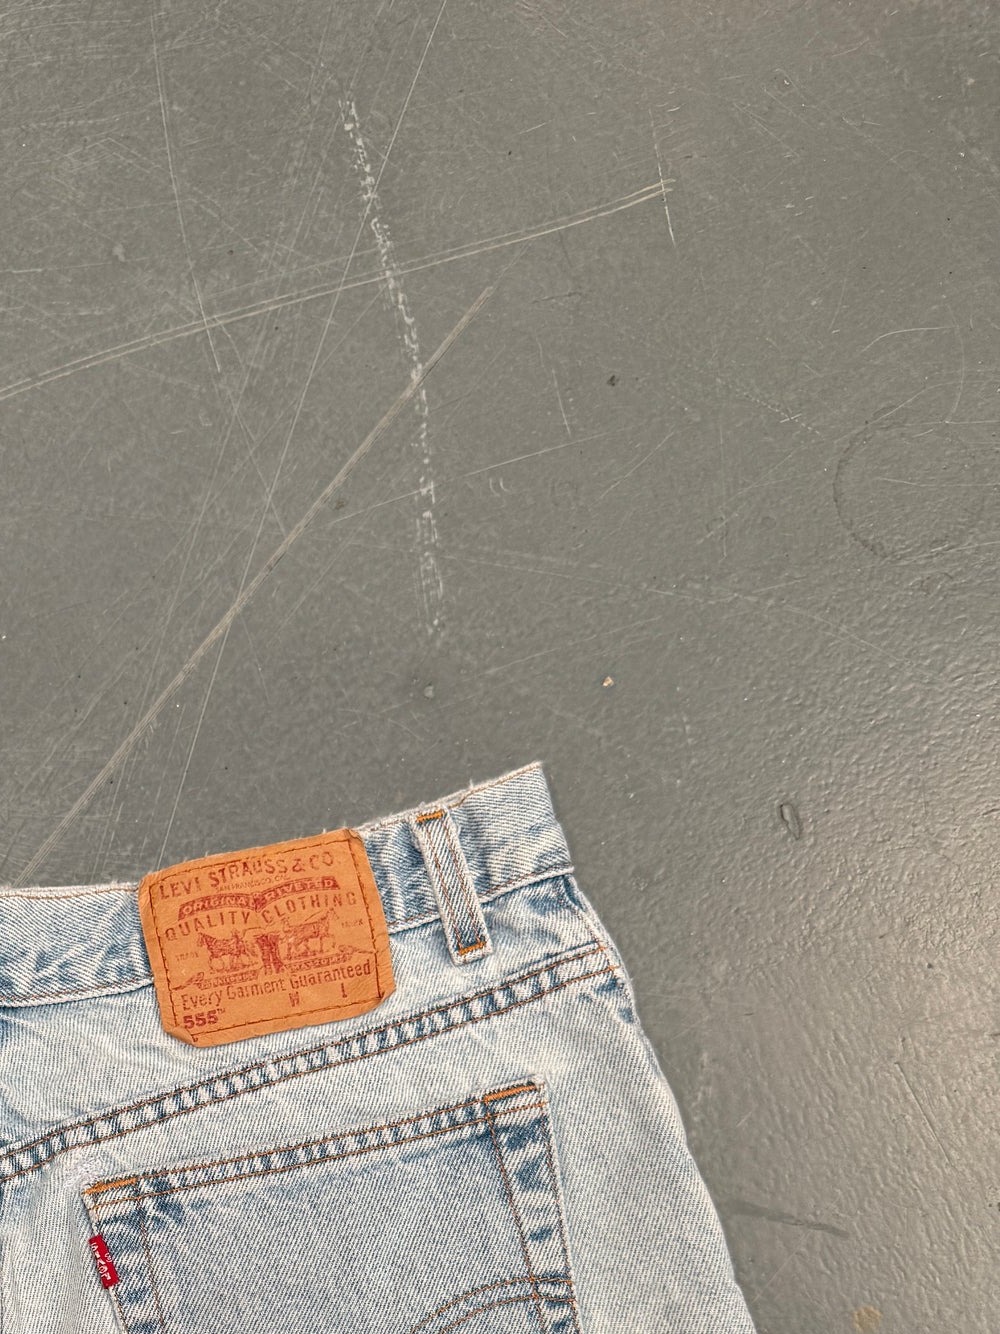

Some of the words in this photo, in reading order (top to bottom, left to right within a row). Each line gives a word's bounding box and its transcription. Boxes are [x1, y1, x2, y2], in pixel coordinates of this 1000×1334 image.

[160, 876, 202, 900] LEVI
[208, 858, 288, 888] STRAUSS
[165, 911, 250, 941] QUALITY
[261, 891, 357, 924] CLOTHING
[181, 990, 223, 1011] Every
[226, 979, 287, 1000] Garment
[289, 958, 372, 990] Guaranteed
